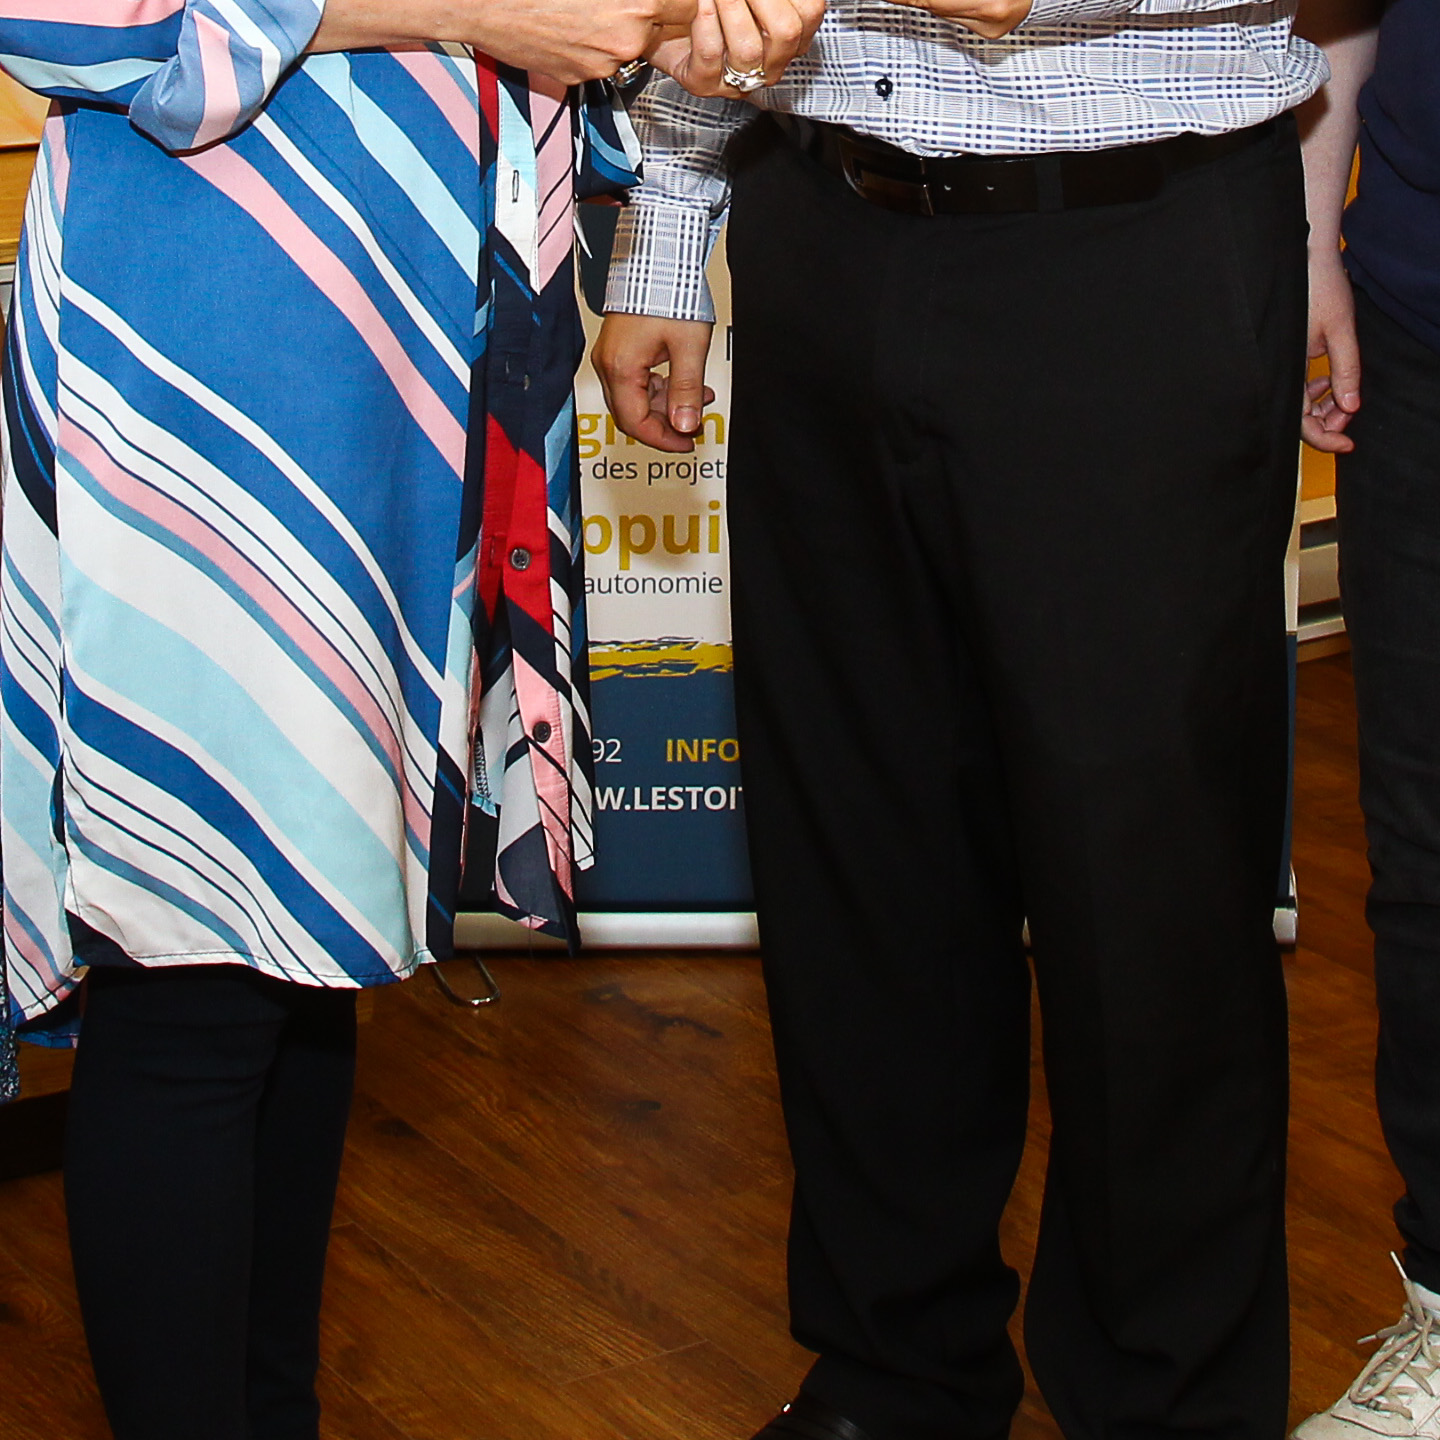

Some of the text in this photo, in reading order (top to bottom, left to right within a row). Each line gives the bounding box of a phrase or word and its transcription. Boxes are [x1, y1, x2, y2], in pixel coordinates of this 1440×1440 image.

[592, 456, 638, 480] des
[647, 456, 727, 486] projet
[585, 571, 723, 595] autonomie
[665, 738, 740, 763] INFO
[594, 786, 743, 811] W.LESTOI
